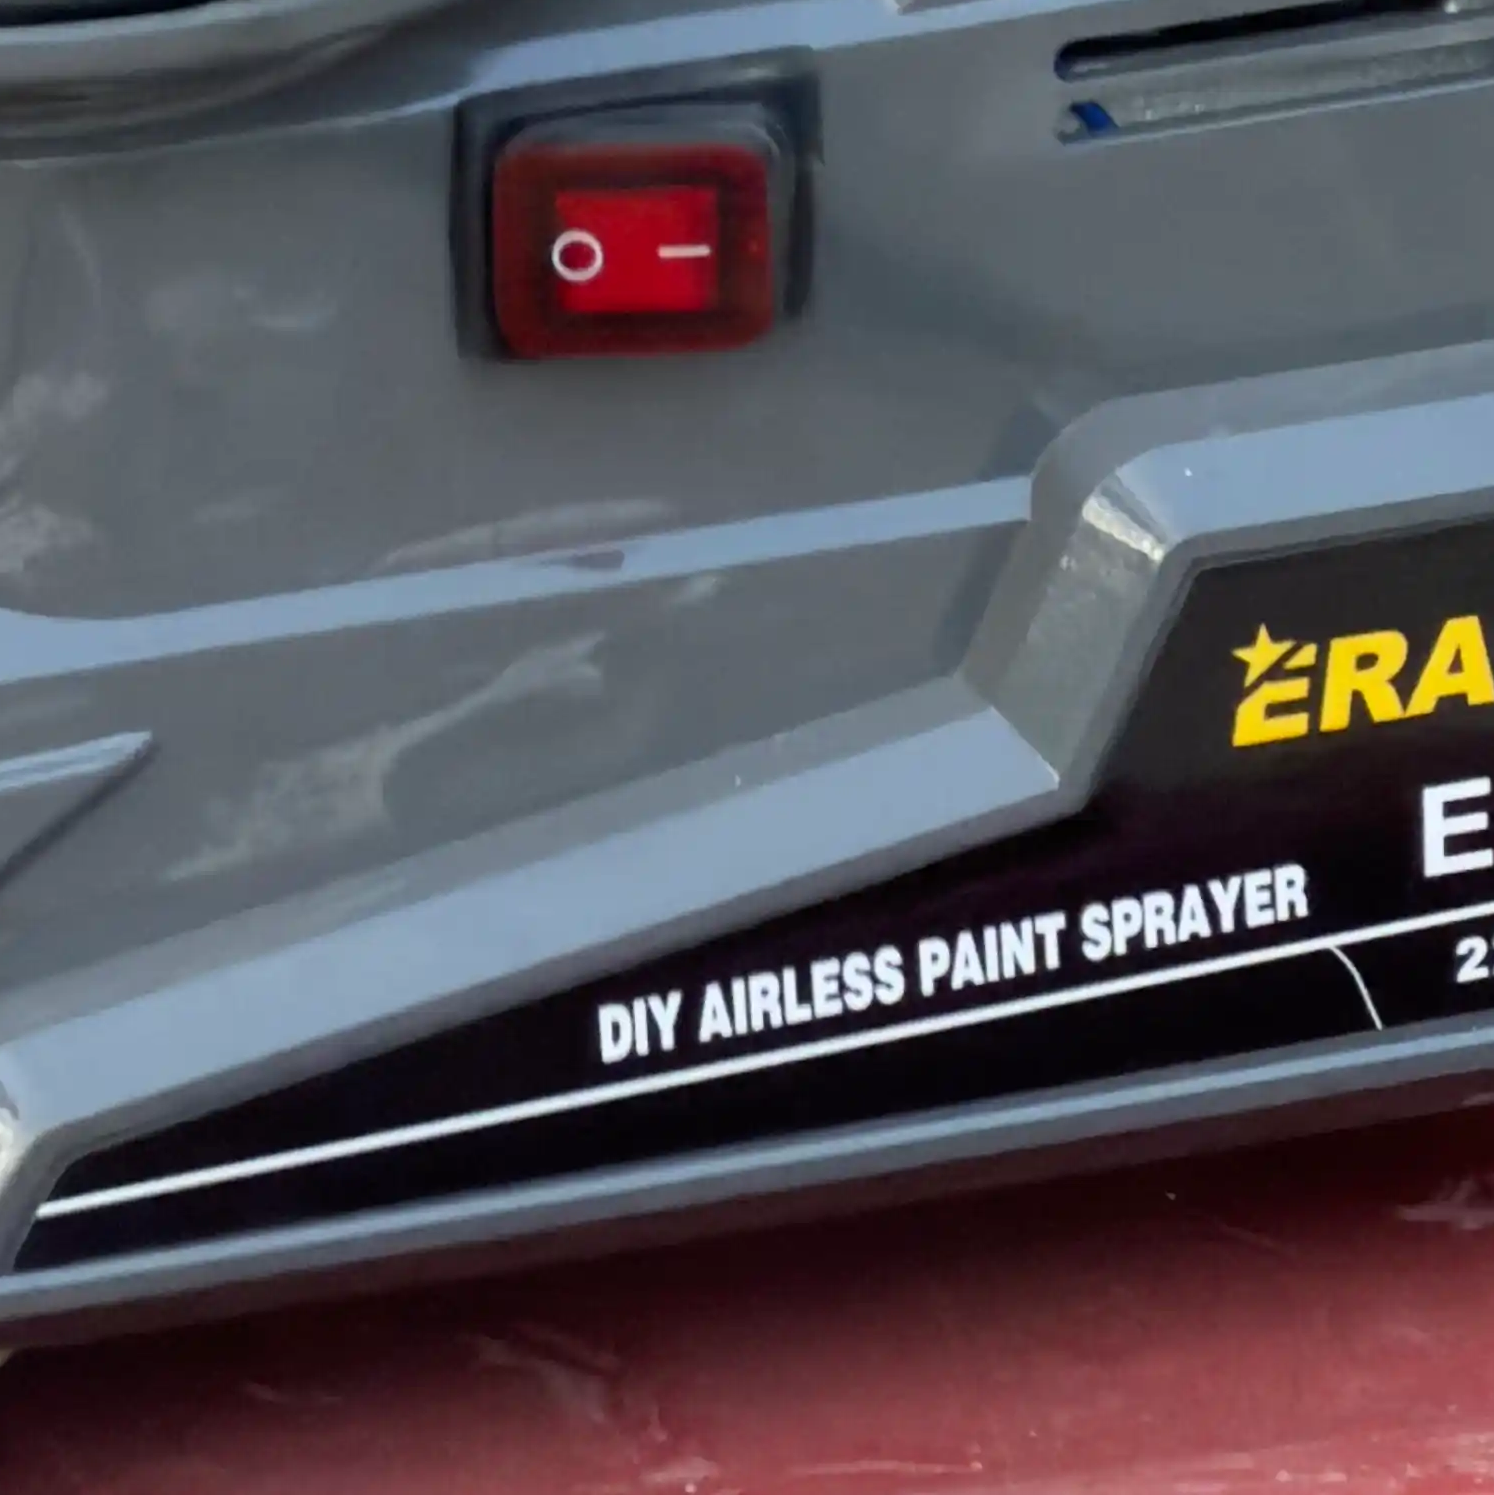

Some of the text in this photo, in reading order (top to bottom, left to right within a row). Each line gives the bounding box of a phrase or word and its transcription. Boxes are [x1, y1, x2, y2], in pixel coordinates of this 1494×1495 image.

[599, 863, 1310, 1064] DIY AIRLESS PAINT SPRAYER
